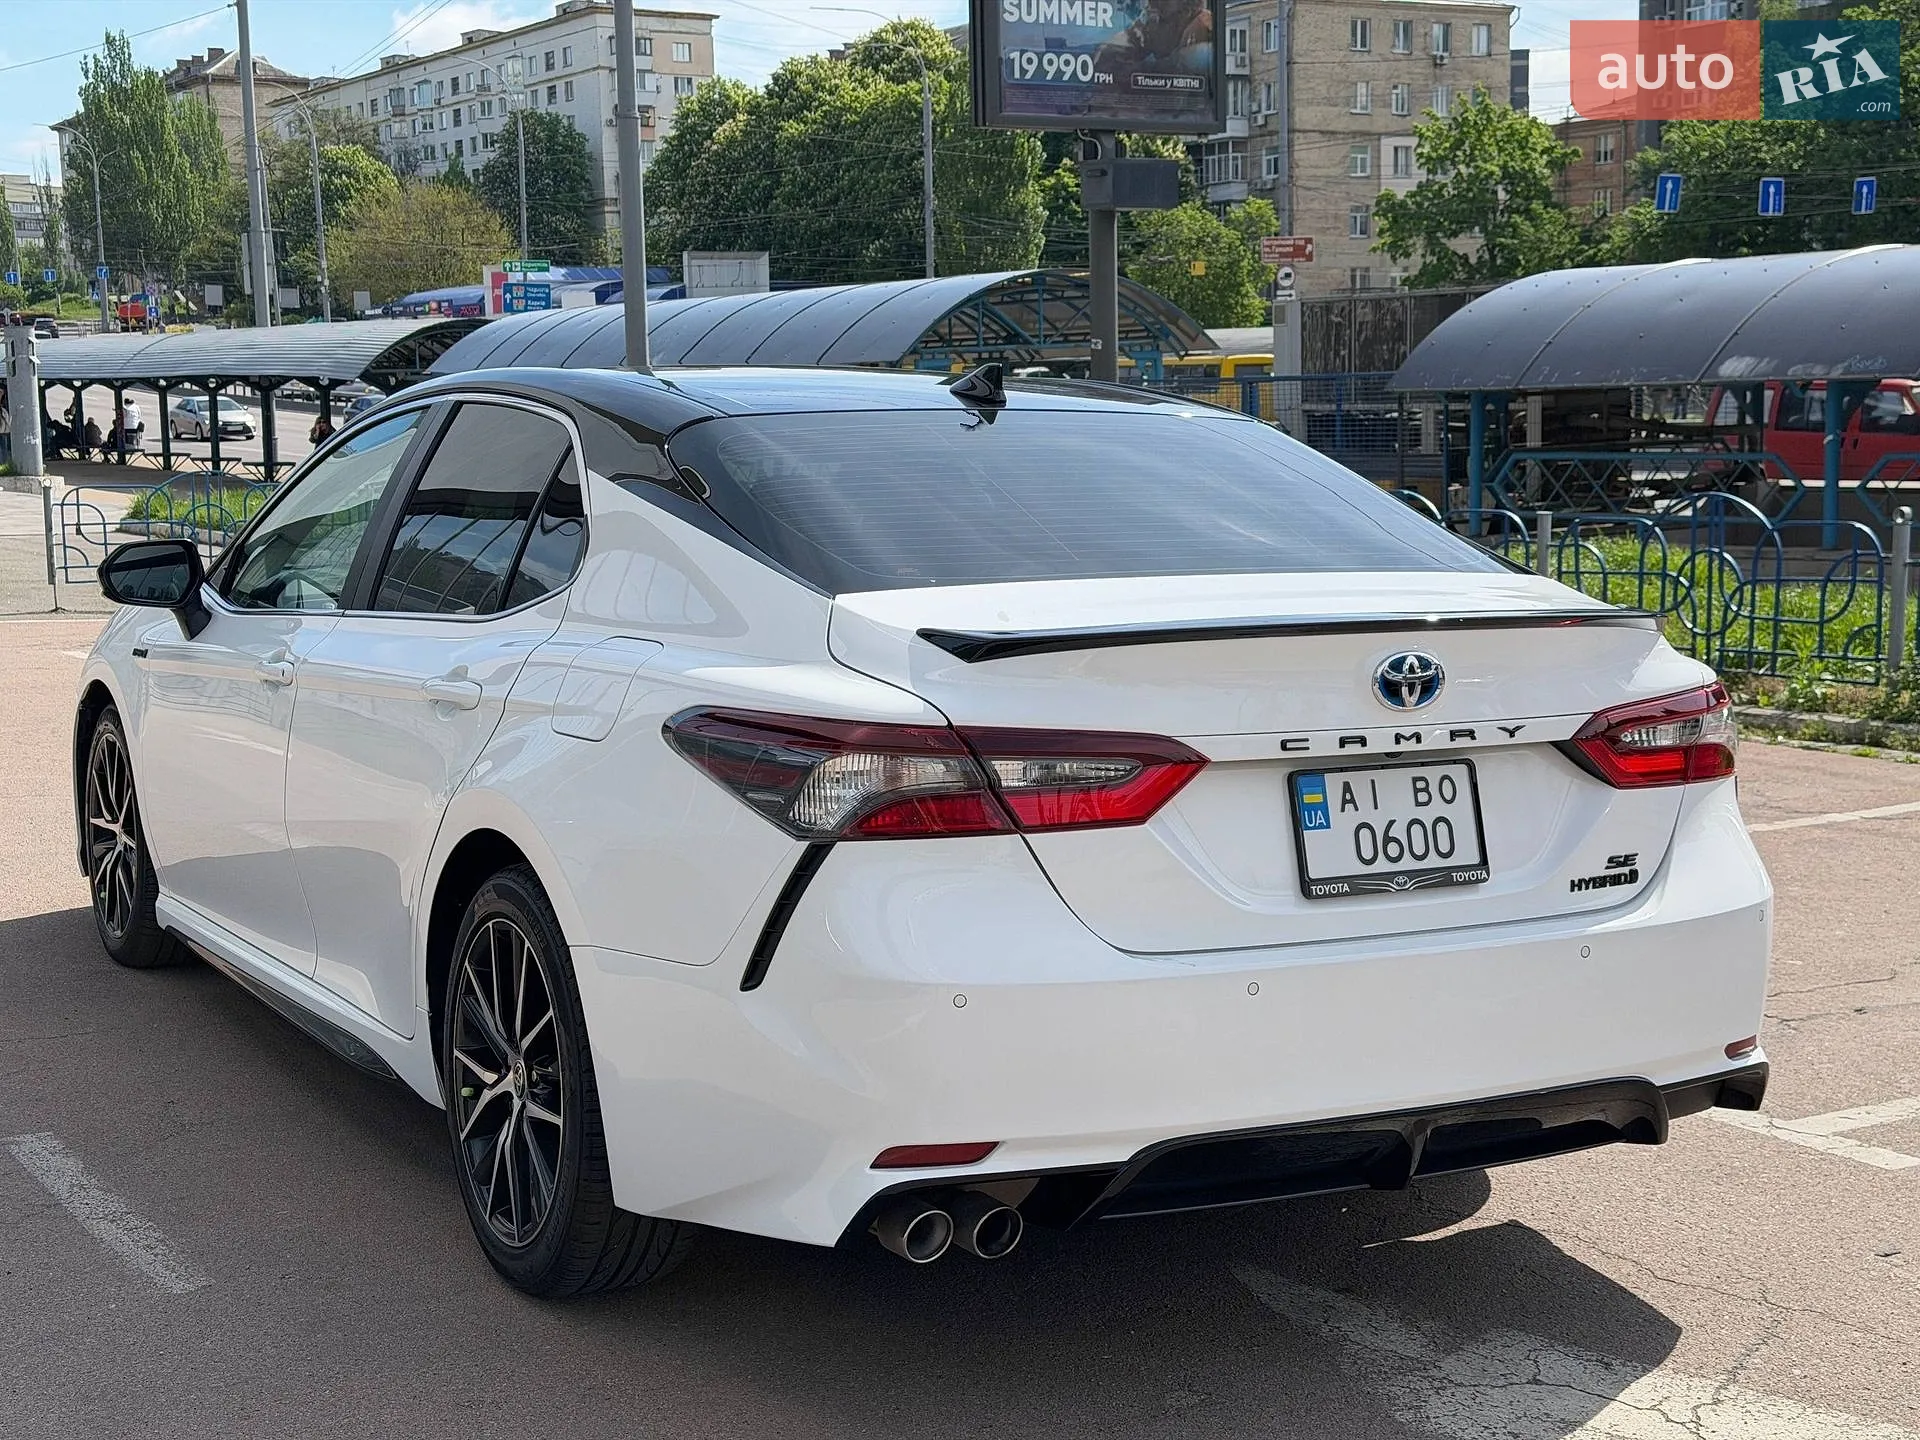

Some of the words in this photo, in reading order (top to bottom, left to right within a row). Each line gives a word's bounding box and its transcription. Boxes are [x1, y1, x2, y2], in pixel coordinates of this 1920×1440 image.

[1002, 0, 1113, 28] SUMMER
[1094, 71, 1114, 84] ГРН
[1136, 76, 1165, 87] Тільки
[1165, 79, 1173, 89] у
[1173, 78, 1200, 88] КВІТНІ
[1280, 724, 1526, 751] CAMRY
[1340, 778, 1379, 813] AI
[1304, 809, 1327, 828] UA
[1353, 815, 1456, 866] 0600
[1604, 852, 1639, 870] SE
[1450, 869, 1489, 883] TOYOTA
[1569, 871, 1629, 893] HYBRID
[1310, 882, 1351, 896] TOYOTA
